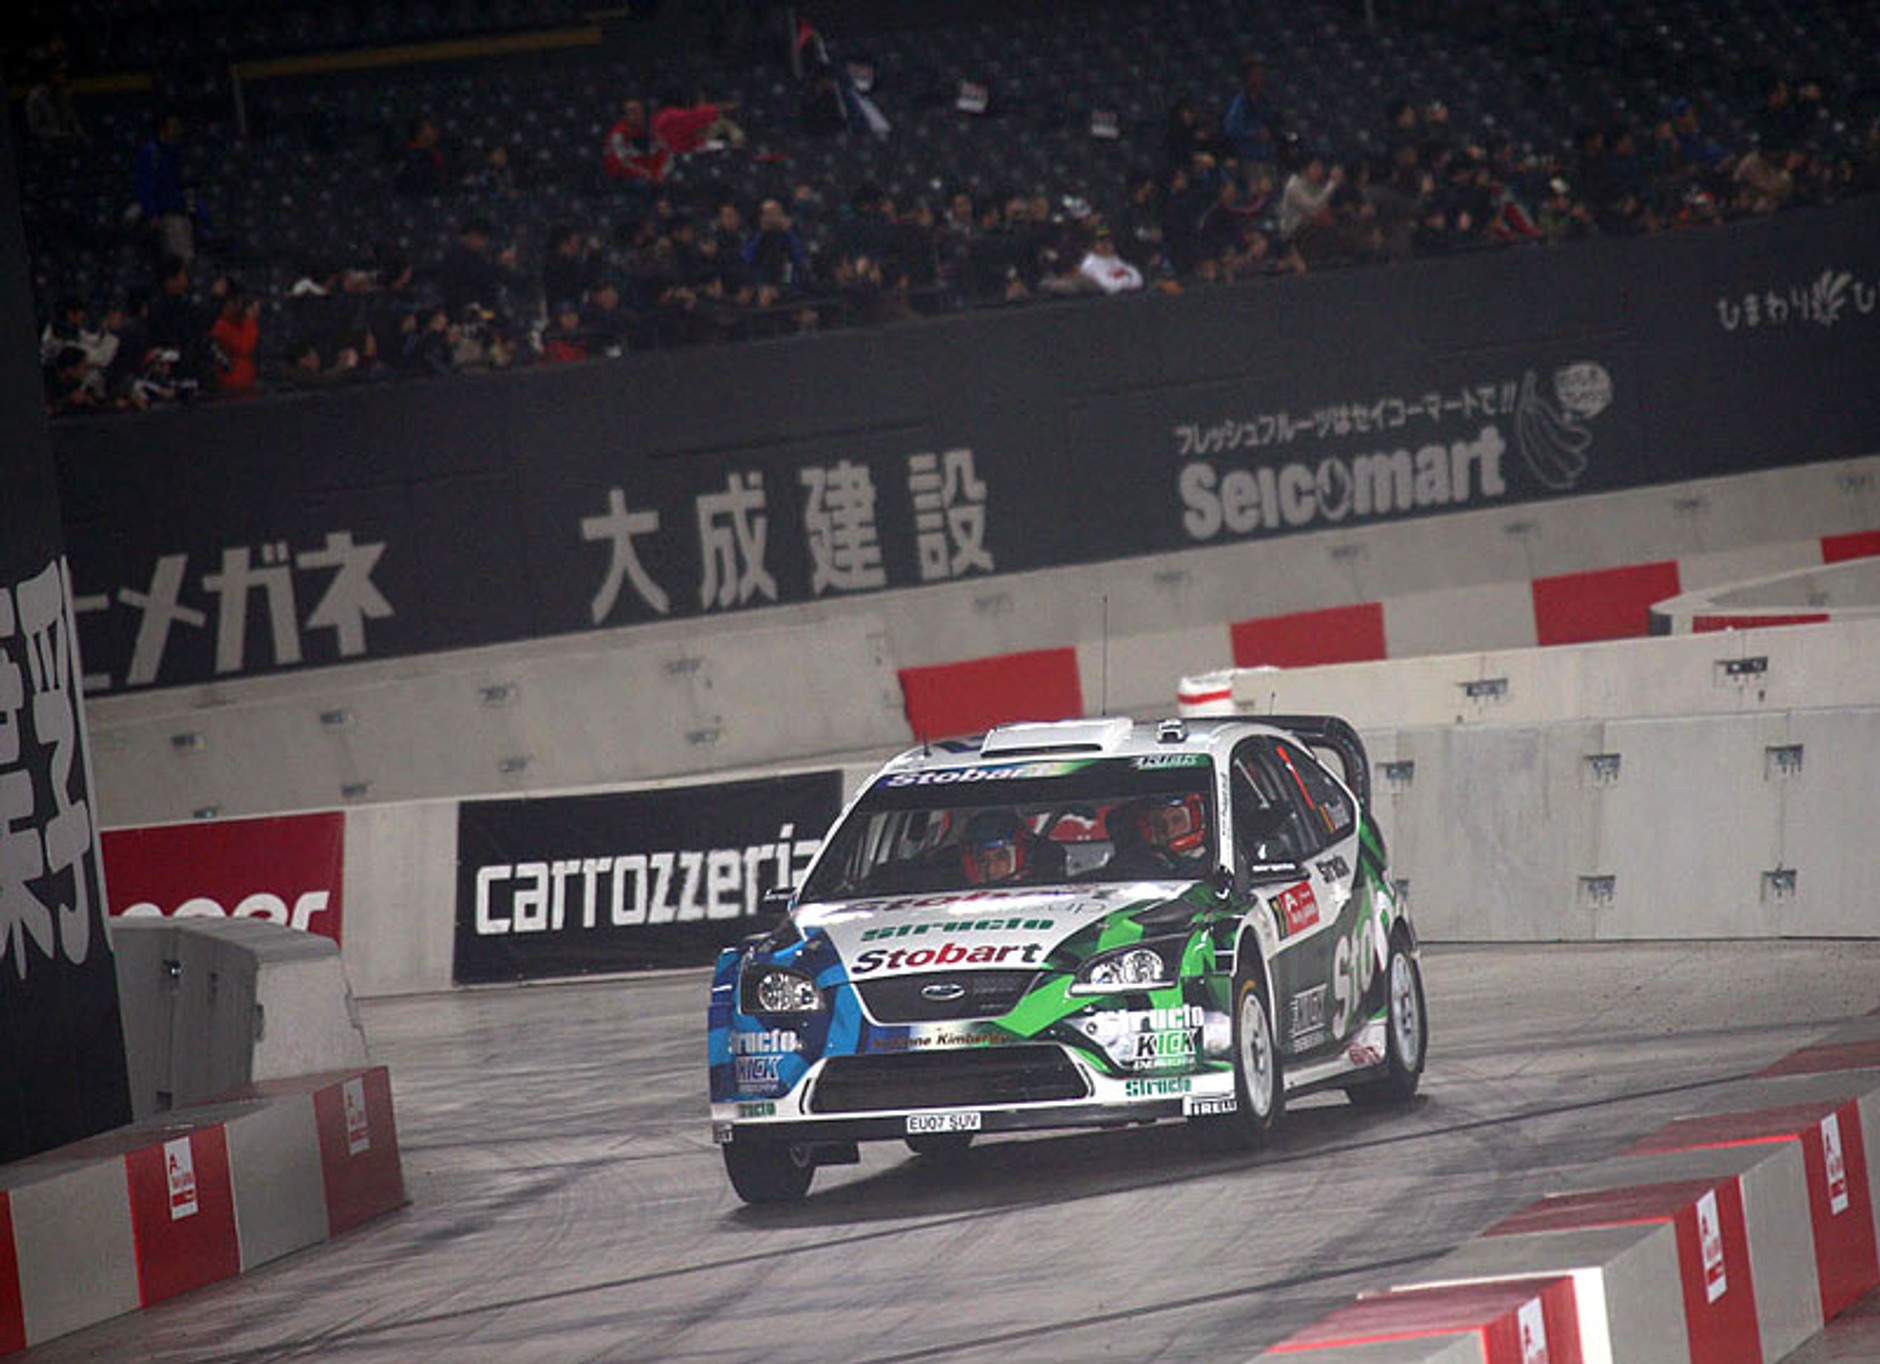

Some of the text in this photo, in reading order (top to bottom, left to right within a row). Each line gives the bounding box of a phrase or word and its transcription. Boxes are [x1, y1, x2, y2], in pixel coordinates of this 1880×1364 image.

[581, 448, 994, 624] 大成建設
[851, 943, 1042, 975] Stobart
[909, 1116, 945, 1131] EU07
